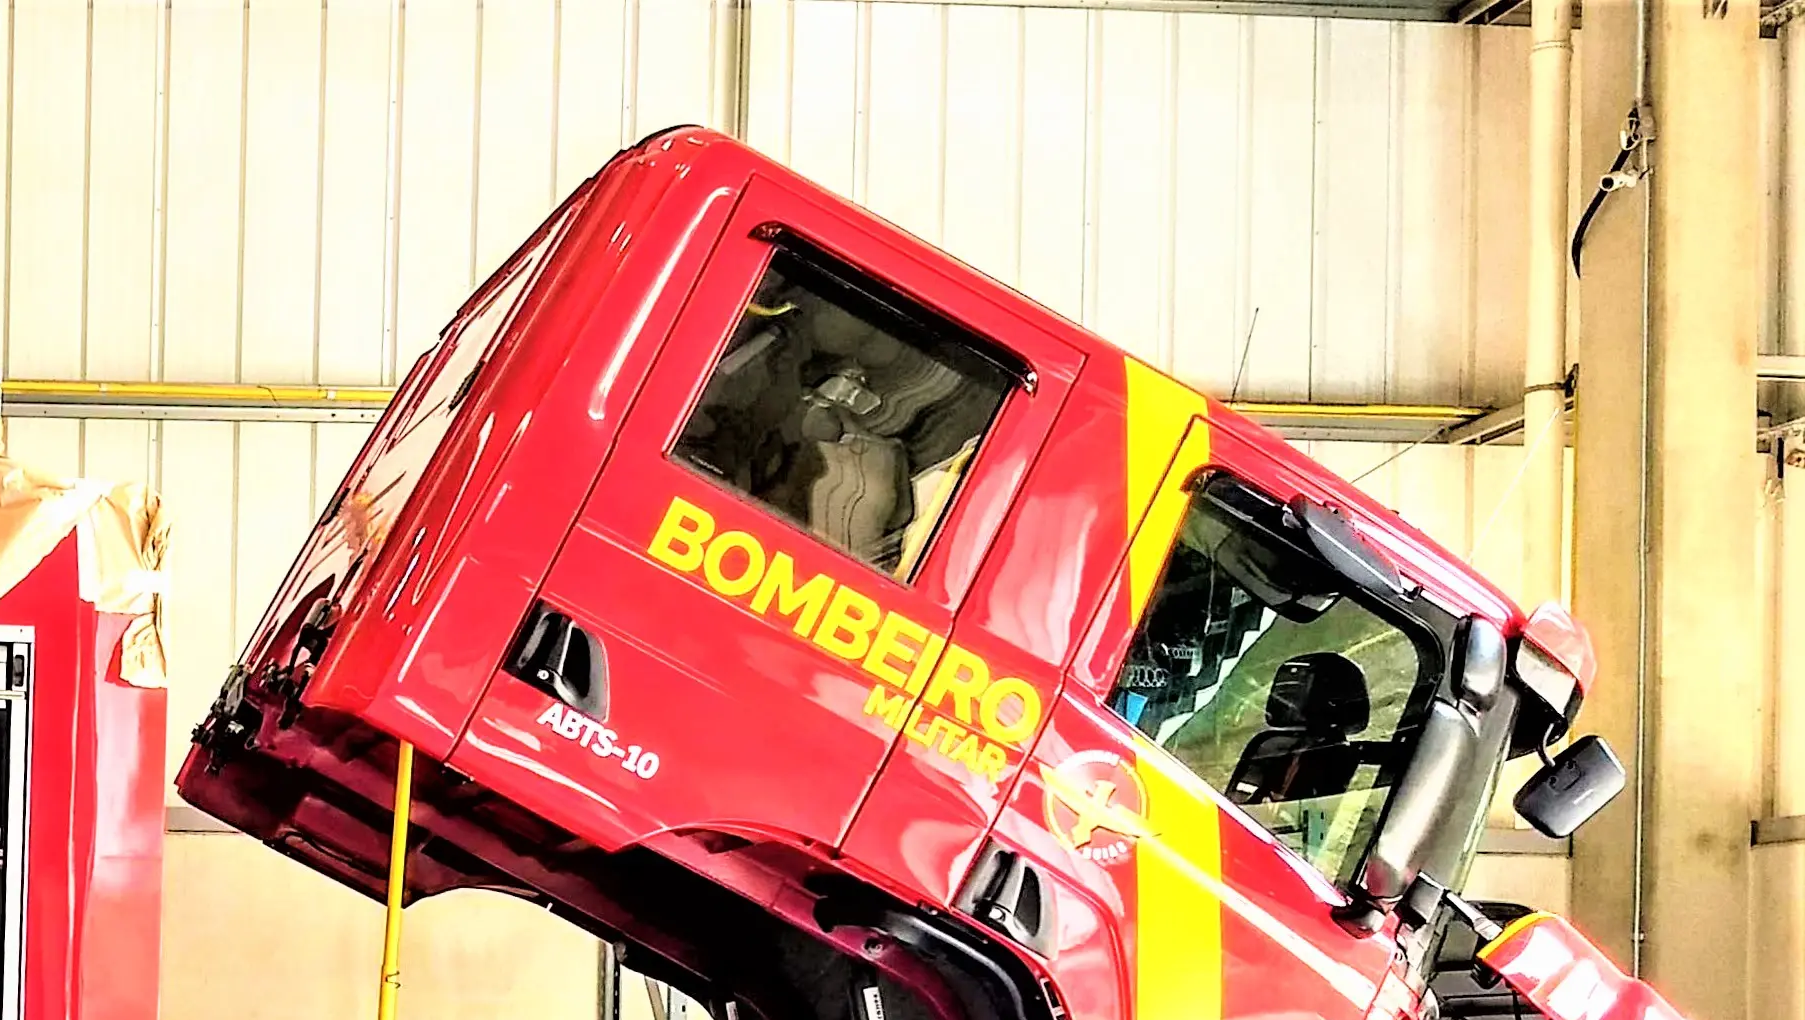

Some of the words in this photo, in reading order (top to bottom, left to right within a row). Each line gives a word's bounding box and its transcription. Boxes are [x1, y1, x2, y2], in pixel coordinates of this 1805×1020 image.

[647, 495, 1042, 744] BOMBEIRO
[536, 702, 660, 779] ABTS-10
[864, 684, 1009, 783] MILITAR
